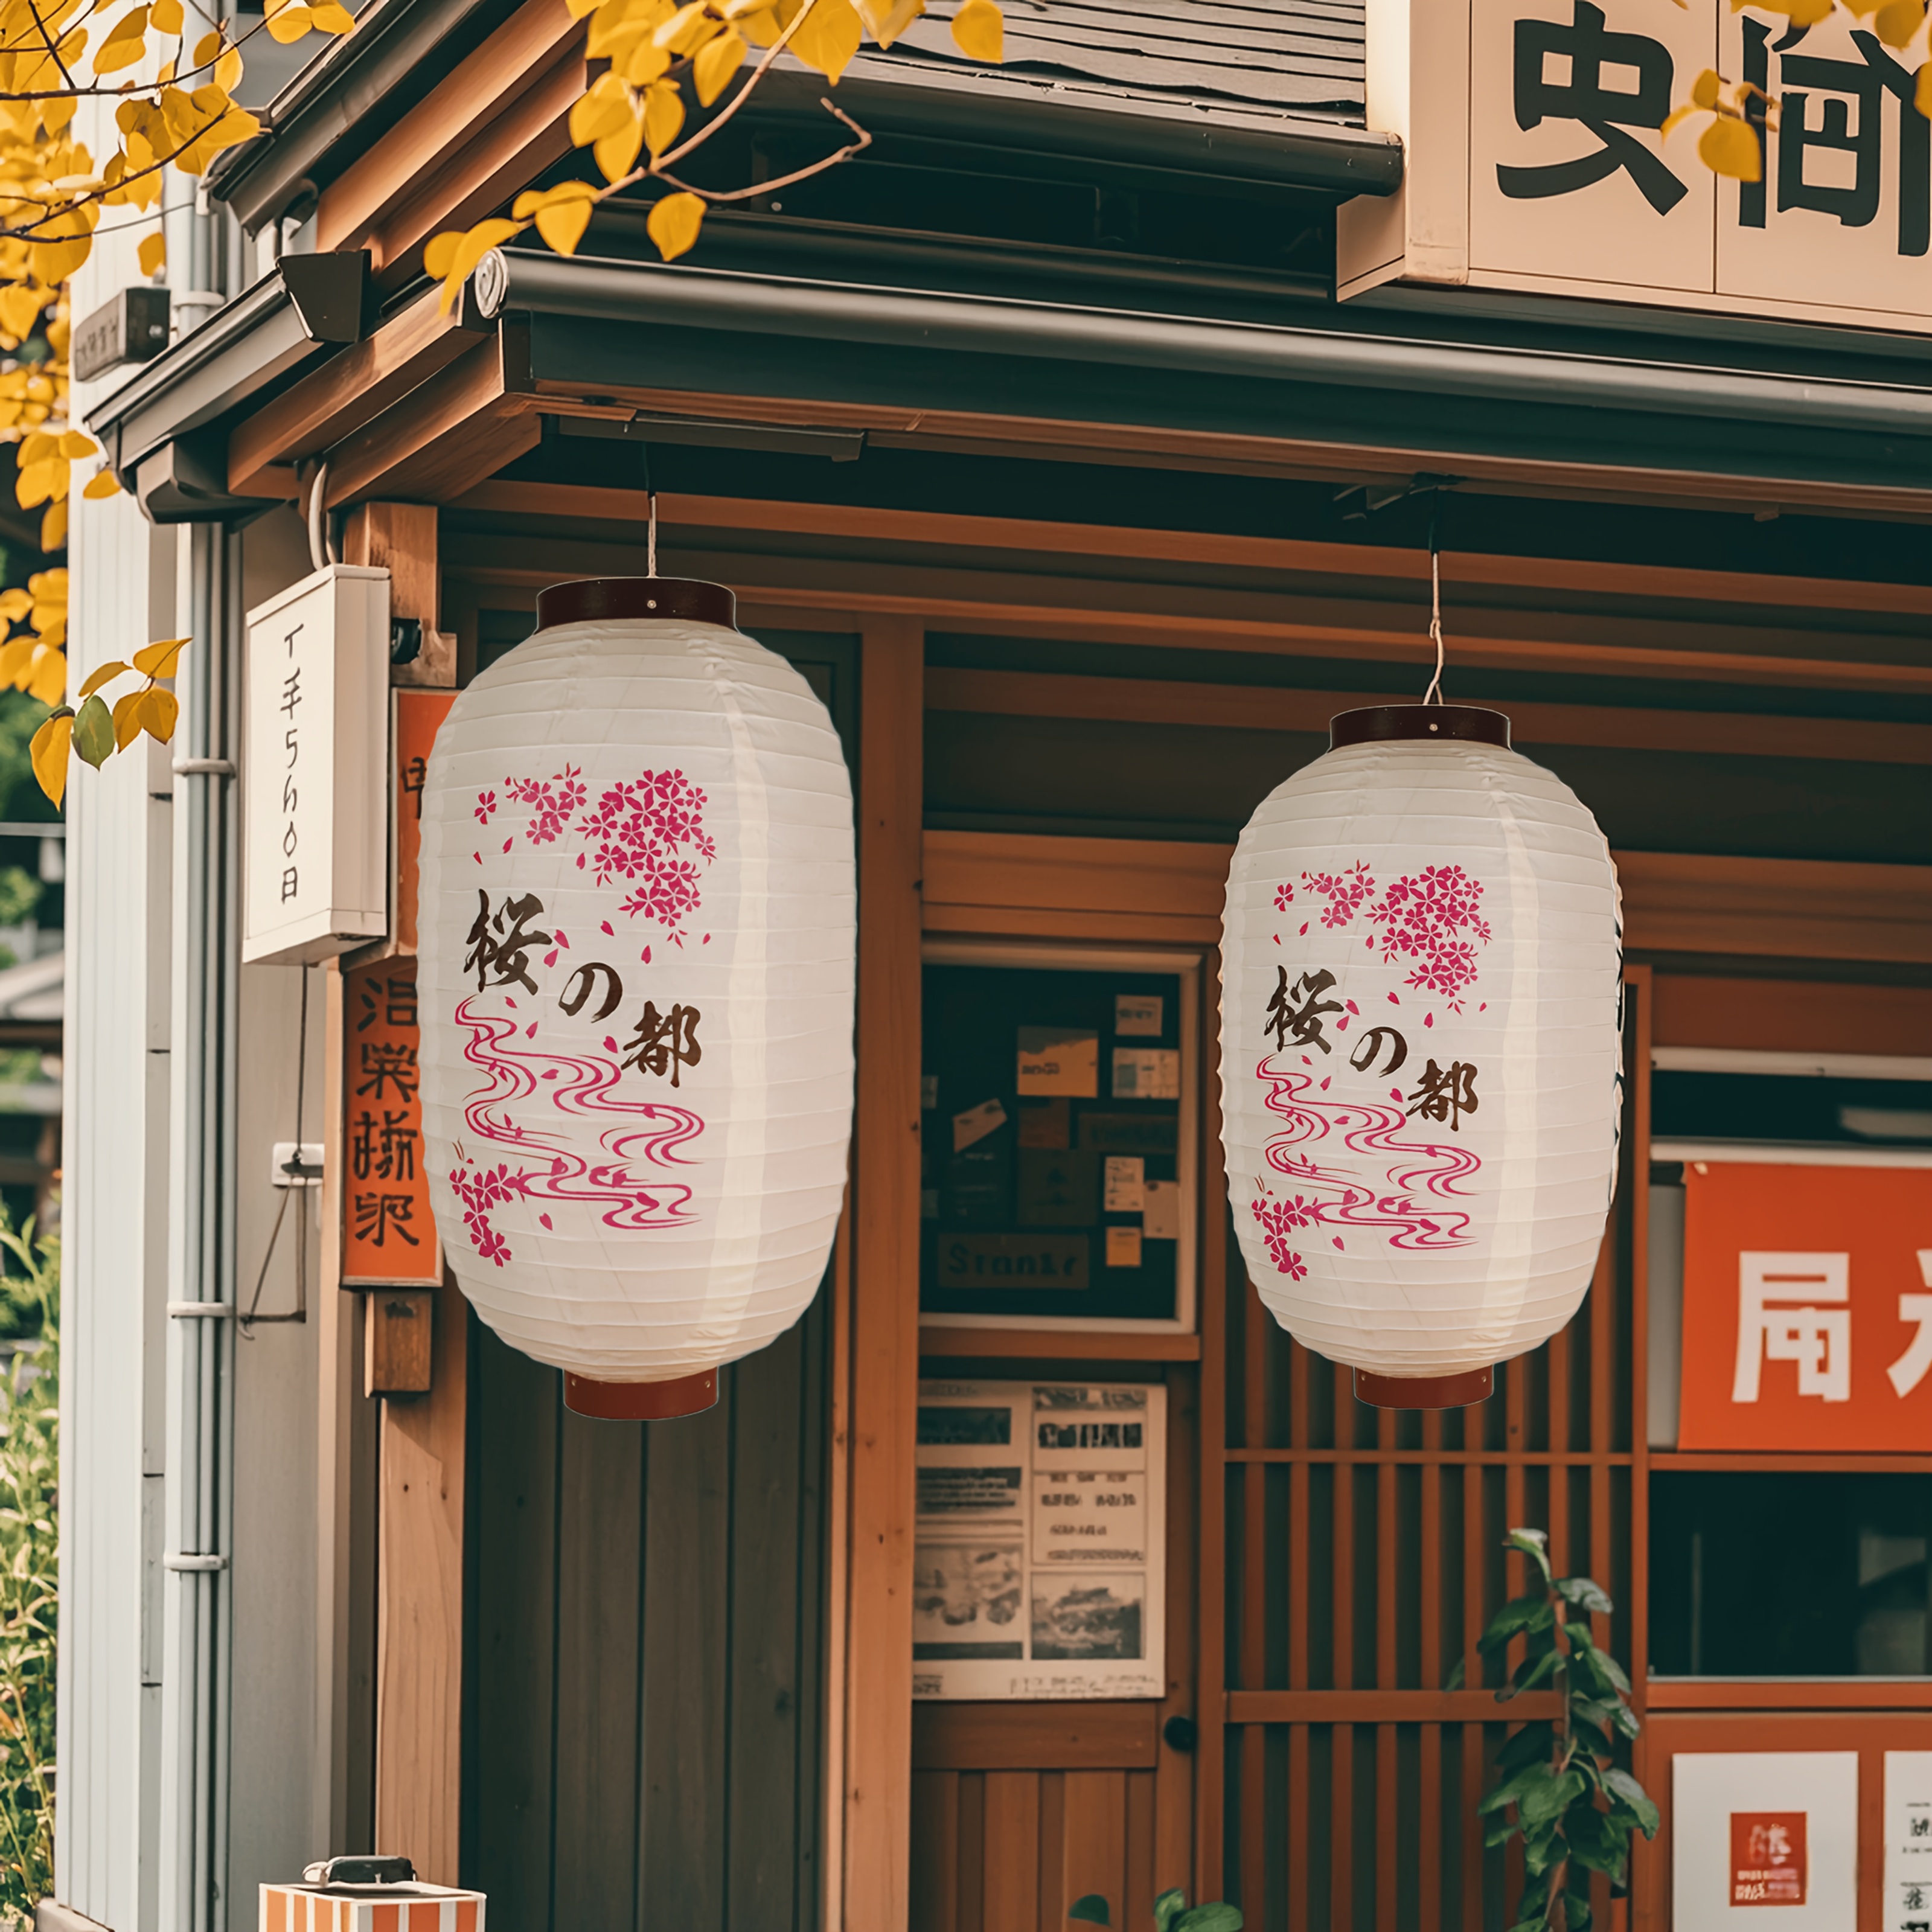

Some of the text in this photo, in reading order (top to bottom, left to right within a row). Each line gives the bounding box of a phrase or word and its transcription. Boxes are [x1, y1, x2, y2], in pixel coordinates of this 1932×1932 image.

[464, 889, 702, 1089] 桜の都
[1263, 965, 1479, 1131] 桜の都
